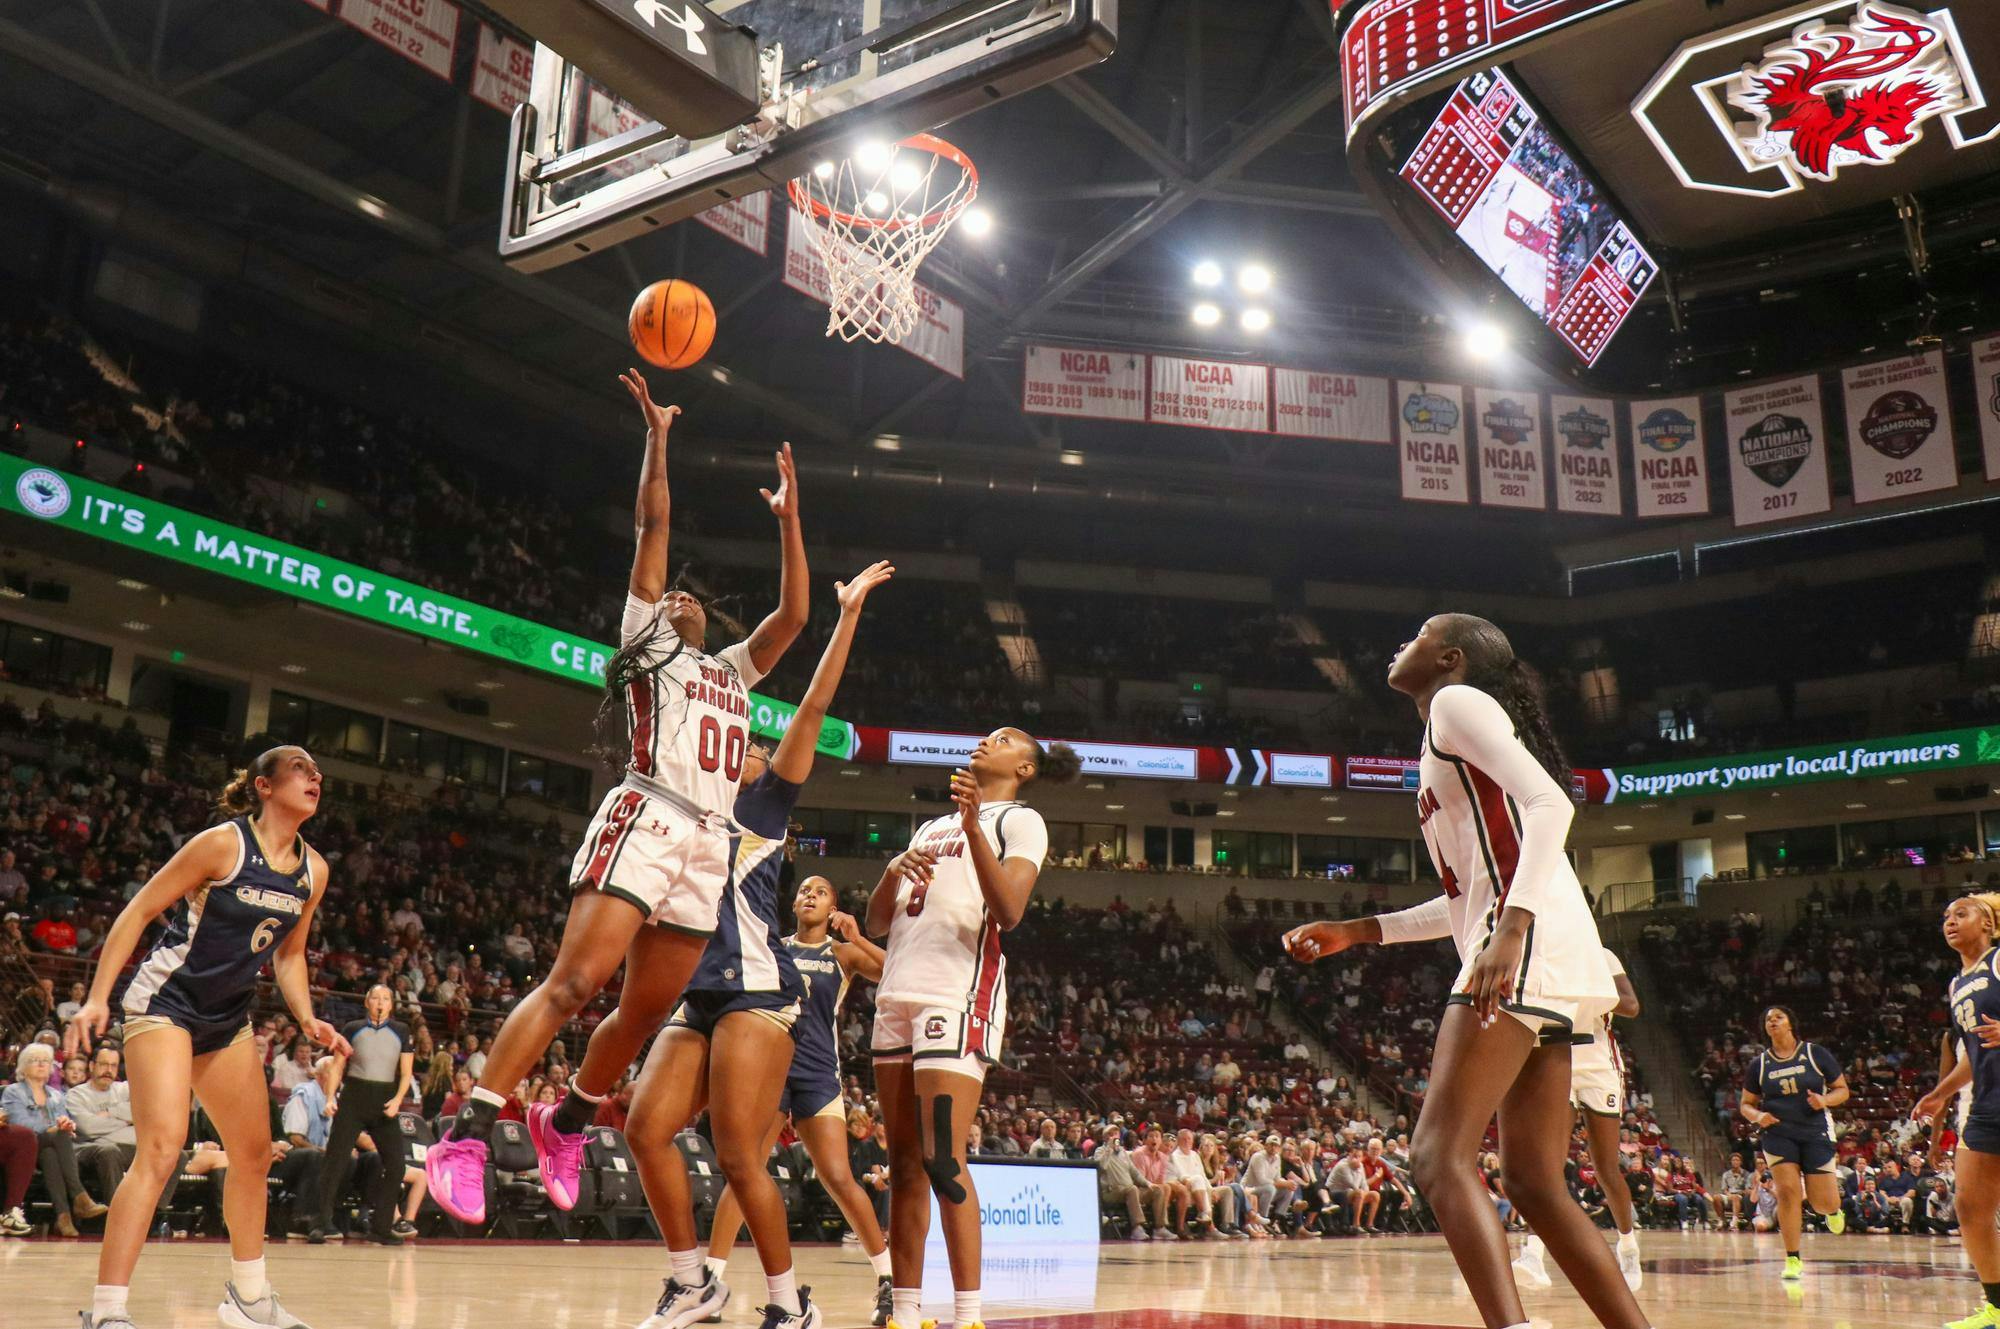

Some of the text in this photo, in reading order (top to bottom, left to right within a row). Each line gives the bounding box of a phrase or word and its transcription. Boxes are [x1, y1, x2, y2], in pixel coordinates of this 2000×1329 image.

[1371, 1, 1393, 20] PTS
[1405, 20, 1416, 32] 2
[1438, 5, 1446, 16] 1
[1352, 7, 1414, 55] 00 4 1
[1379, 47, 1388, 60] 2
[1406, 33, 1416, 44] 4
[1437, 19, 1448, 30] 0
[1465, 6, 1477, 18] 0
[1379, 61, 1388, 73] 2
[1406, 46, 1417, 58] 0
[1438, 32, 1449, 44] 0
[1466, 20, 1478, 31] 0
[1379, 74, 1389, 85] 0
[1407, 60, 1418, 71] 0
[1439, 46, 1450, 57] 0
[1467, 34, 1478, 45] 0
[1470, 71, 1491, 96] 13
[1474, 117, 1483, 127] 4
[1449, 136, 1457, 145] 4
[1471, 177, 1479, 186] 0
[1633, 269, 1647, 285] 5
[1060, 352, 1110, 374] NCAA
[1886, 357, 1926, 372] CAROLINA
[1185, 363, 1233, 385] NCAA
[1887, 366, 1938, 383] BASKETBALL
[1307, 375, 1357, 397] NCAA
[1739, 385, 1804, 405] SOUTH CAROLINA
[1212, 397, 1237, 410] 2012
[1238, 400, 1264, 412] 2014
[1766, 394, 1813, 410] BASKETBALL
[1867, 418, 1931, 439] CHAMPIONS
[1743, 428, 1809, 452] NATIONAL
[1406, 440, 1460, 465] NCAA
[1484, 447, 1536, 471] NCAA
[1747, 443, 1807, 465] CHAMPIONS
[1416, 464, 1434, 474] FINAL
[1493, 471, 1511, 480] FINAL
[1561, 453, 1613, 478] NCAA
[1641, 456, 1699, 480] NCAA
[1420, 478, 1449, 490] 2015
[1651, 481, 1671, 490] FINAL
[1885, 468, 1923, 486] 2022
[1500, 484, 1526, 497] 2021
[1575, 490, 1602, 504] 2023
[1657, 492, 1688, 505] 2025
[1763, 492, 1798, 510] 2017
[82, 495, 145, 535] IT'S
[155, 521, 180, 547] A
[194, 530, 321, 590] MATTER
[331, 574, 375, 603] OF
[385, 589, 478, 638] TASTE.
[698, 715, 745, 783] 00
[900, 745, 1128, 767] PLAYER LEAD YOU BY:
[1137, 759, 1169, 769] Colonial
[1347, 756, 1363, 764] OUT
[1619, 742, 1960, 796] Support your local farmers
[1278, 767, 1309, 777] Colonial
[251, 917, 282, 954] 6
[1779, 1077, 1799, 1095] 31
[980, 1202, 1031, 1226] olonial
